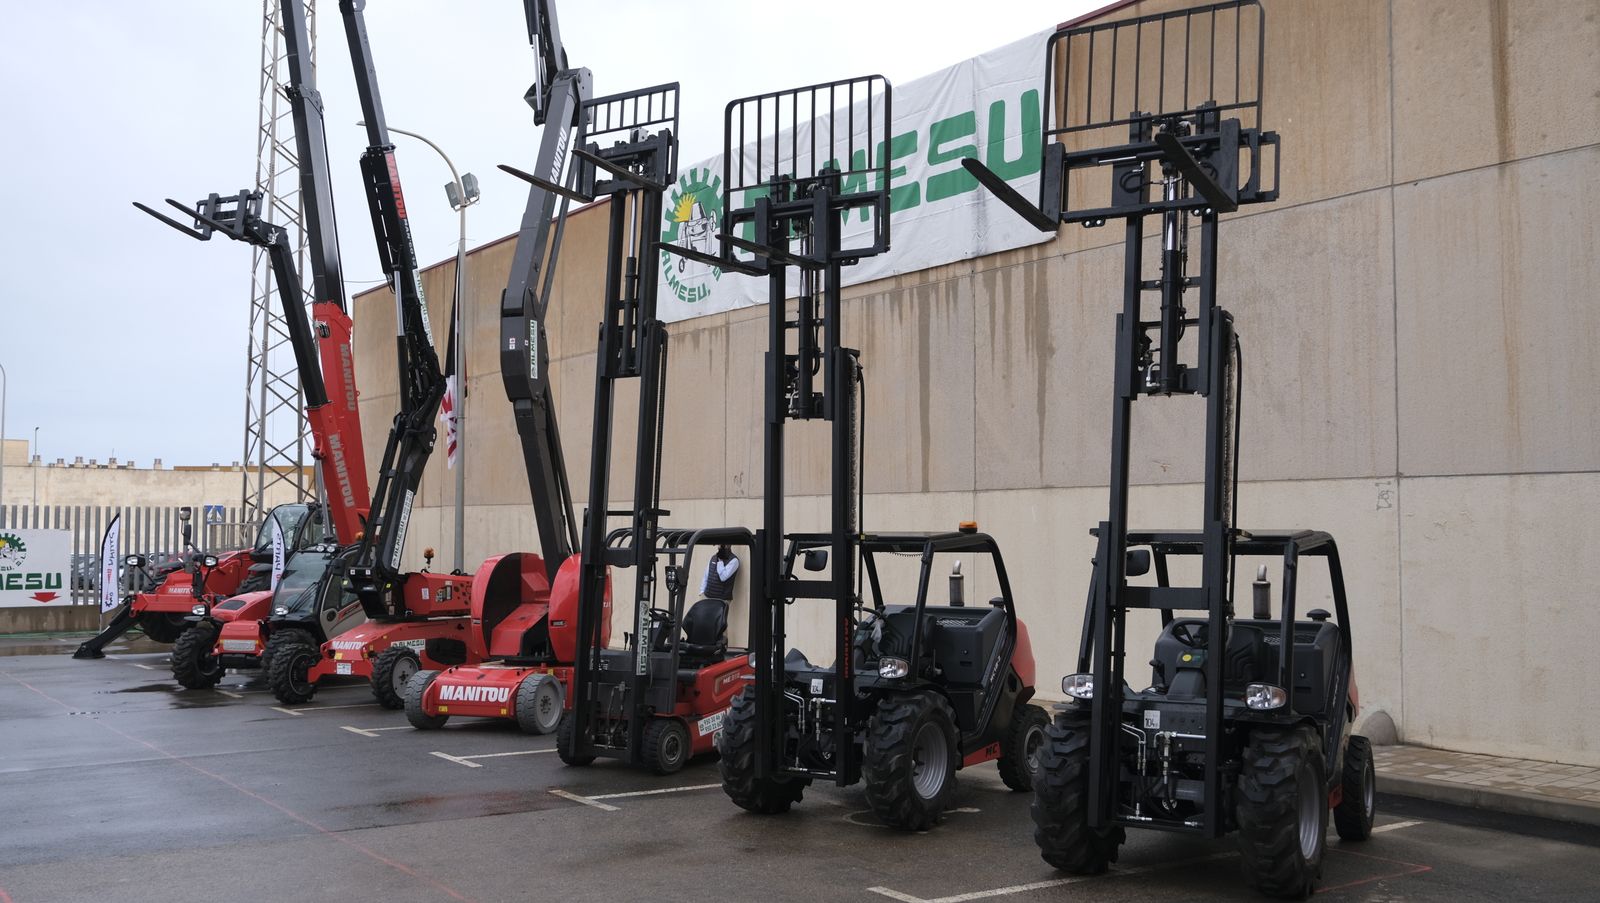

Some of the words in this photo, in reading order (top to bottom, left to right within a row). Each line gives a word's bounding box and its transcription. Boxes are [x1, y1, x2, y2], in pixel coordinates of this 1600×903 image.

[385, 153, 407, 219] MANITOU
[741, 88, 1042, 254] AMESU
[340, 343, 356, 412] MANITOU
[329, 433, 355, 508] MANITOU
[0, 572, 62, 591] ESU
[168, 586, 193, 594] MANITO
[640, 617, 649, 674] ALMESU
[440, 685, 509, 702] MANITOU
